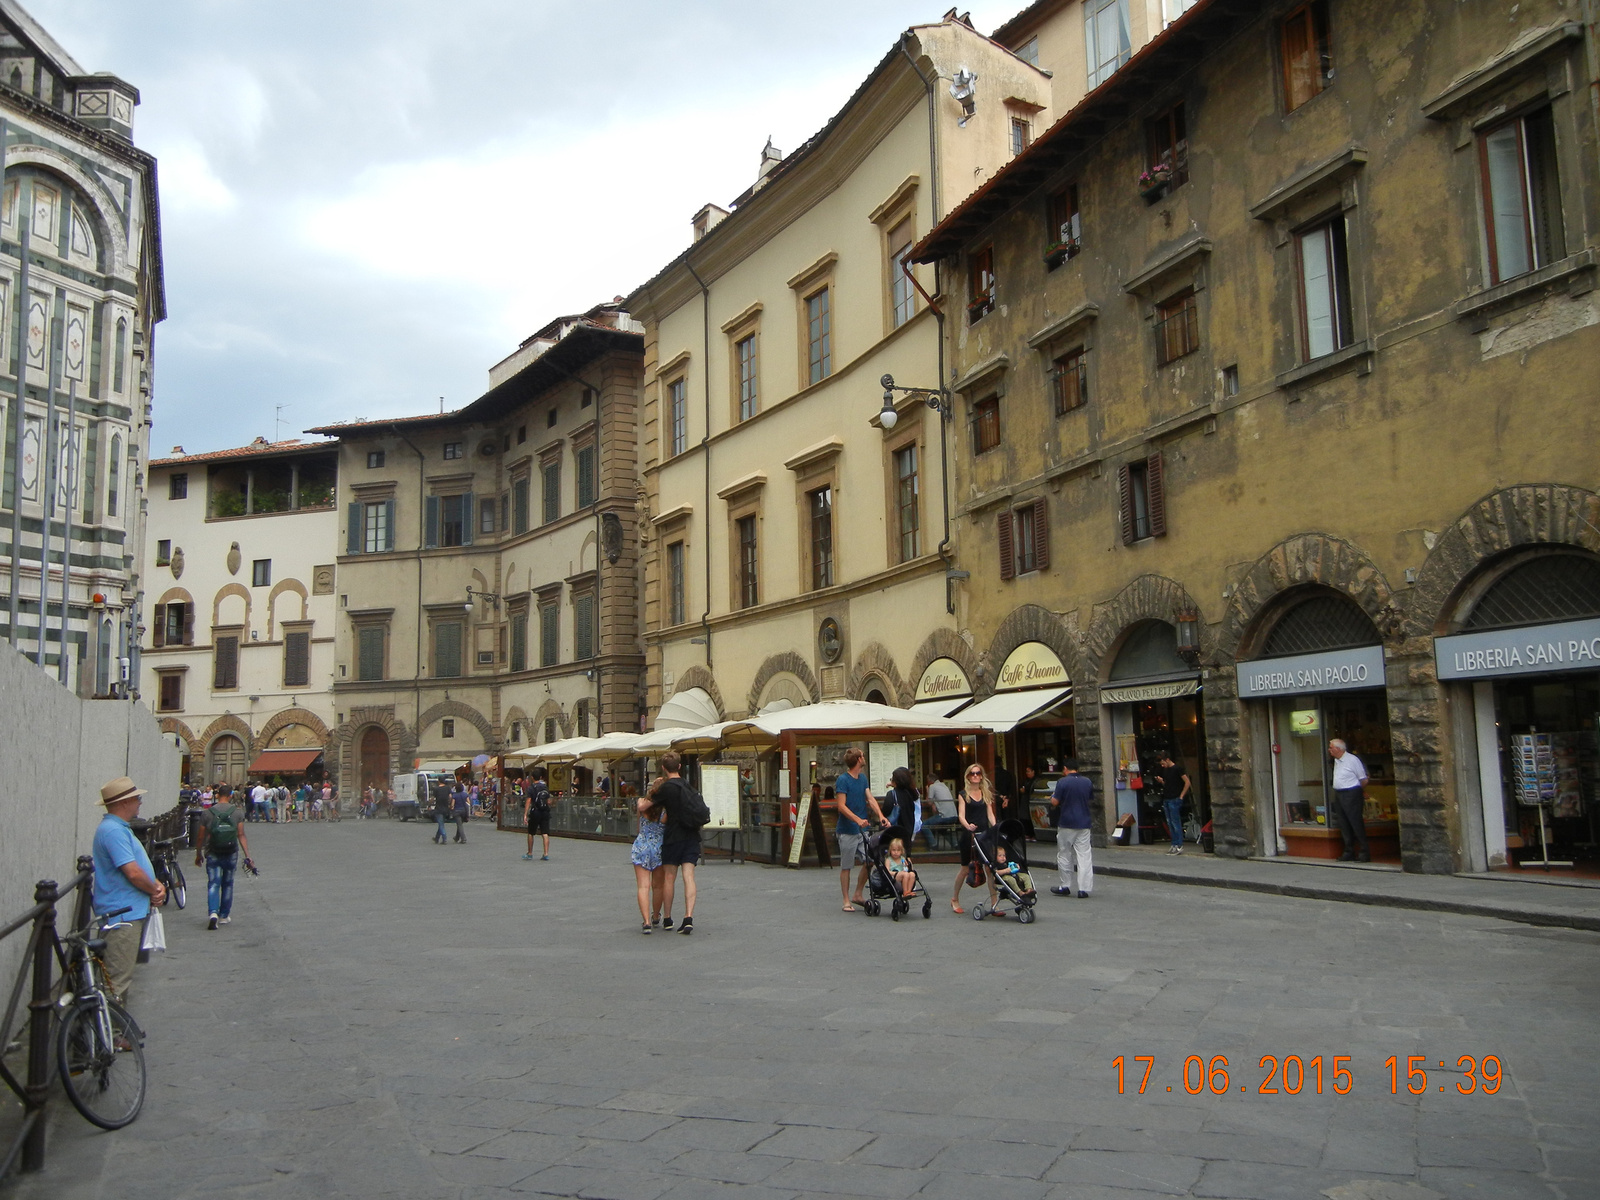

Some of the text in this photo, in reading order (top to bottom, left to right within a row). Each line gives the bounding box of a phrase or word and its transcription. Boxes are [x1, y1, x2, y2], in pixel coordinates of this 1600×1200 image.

[1454, 646, 1523, 672] LIBRERIA
[1525, 641, 1563, 665] SAN
[1024, 660, 1062, 680] Duomo
[1249, 663, 1368, 692] LIBRERIA SAN PAOLO
[923, 674, 962, 697] Caffetteria
